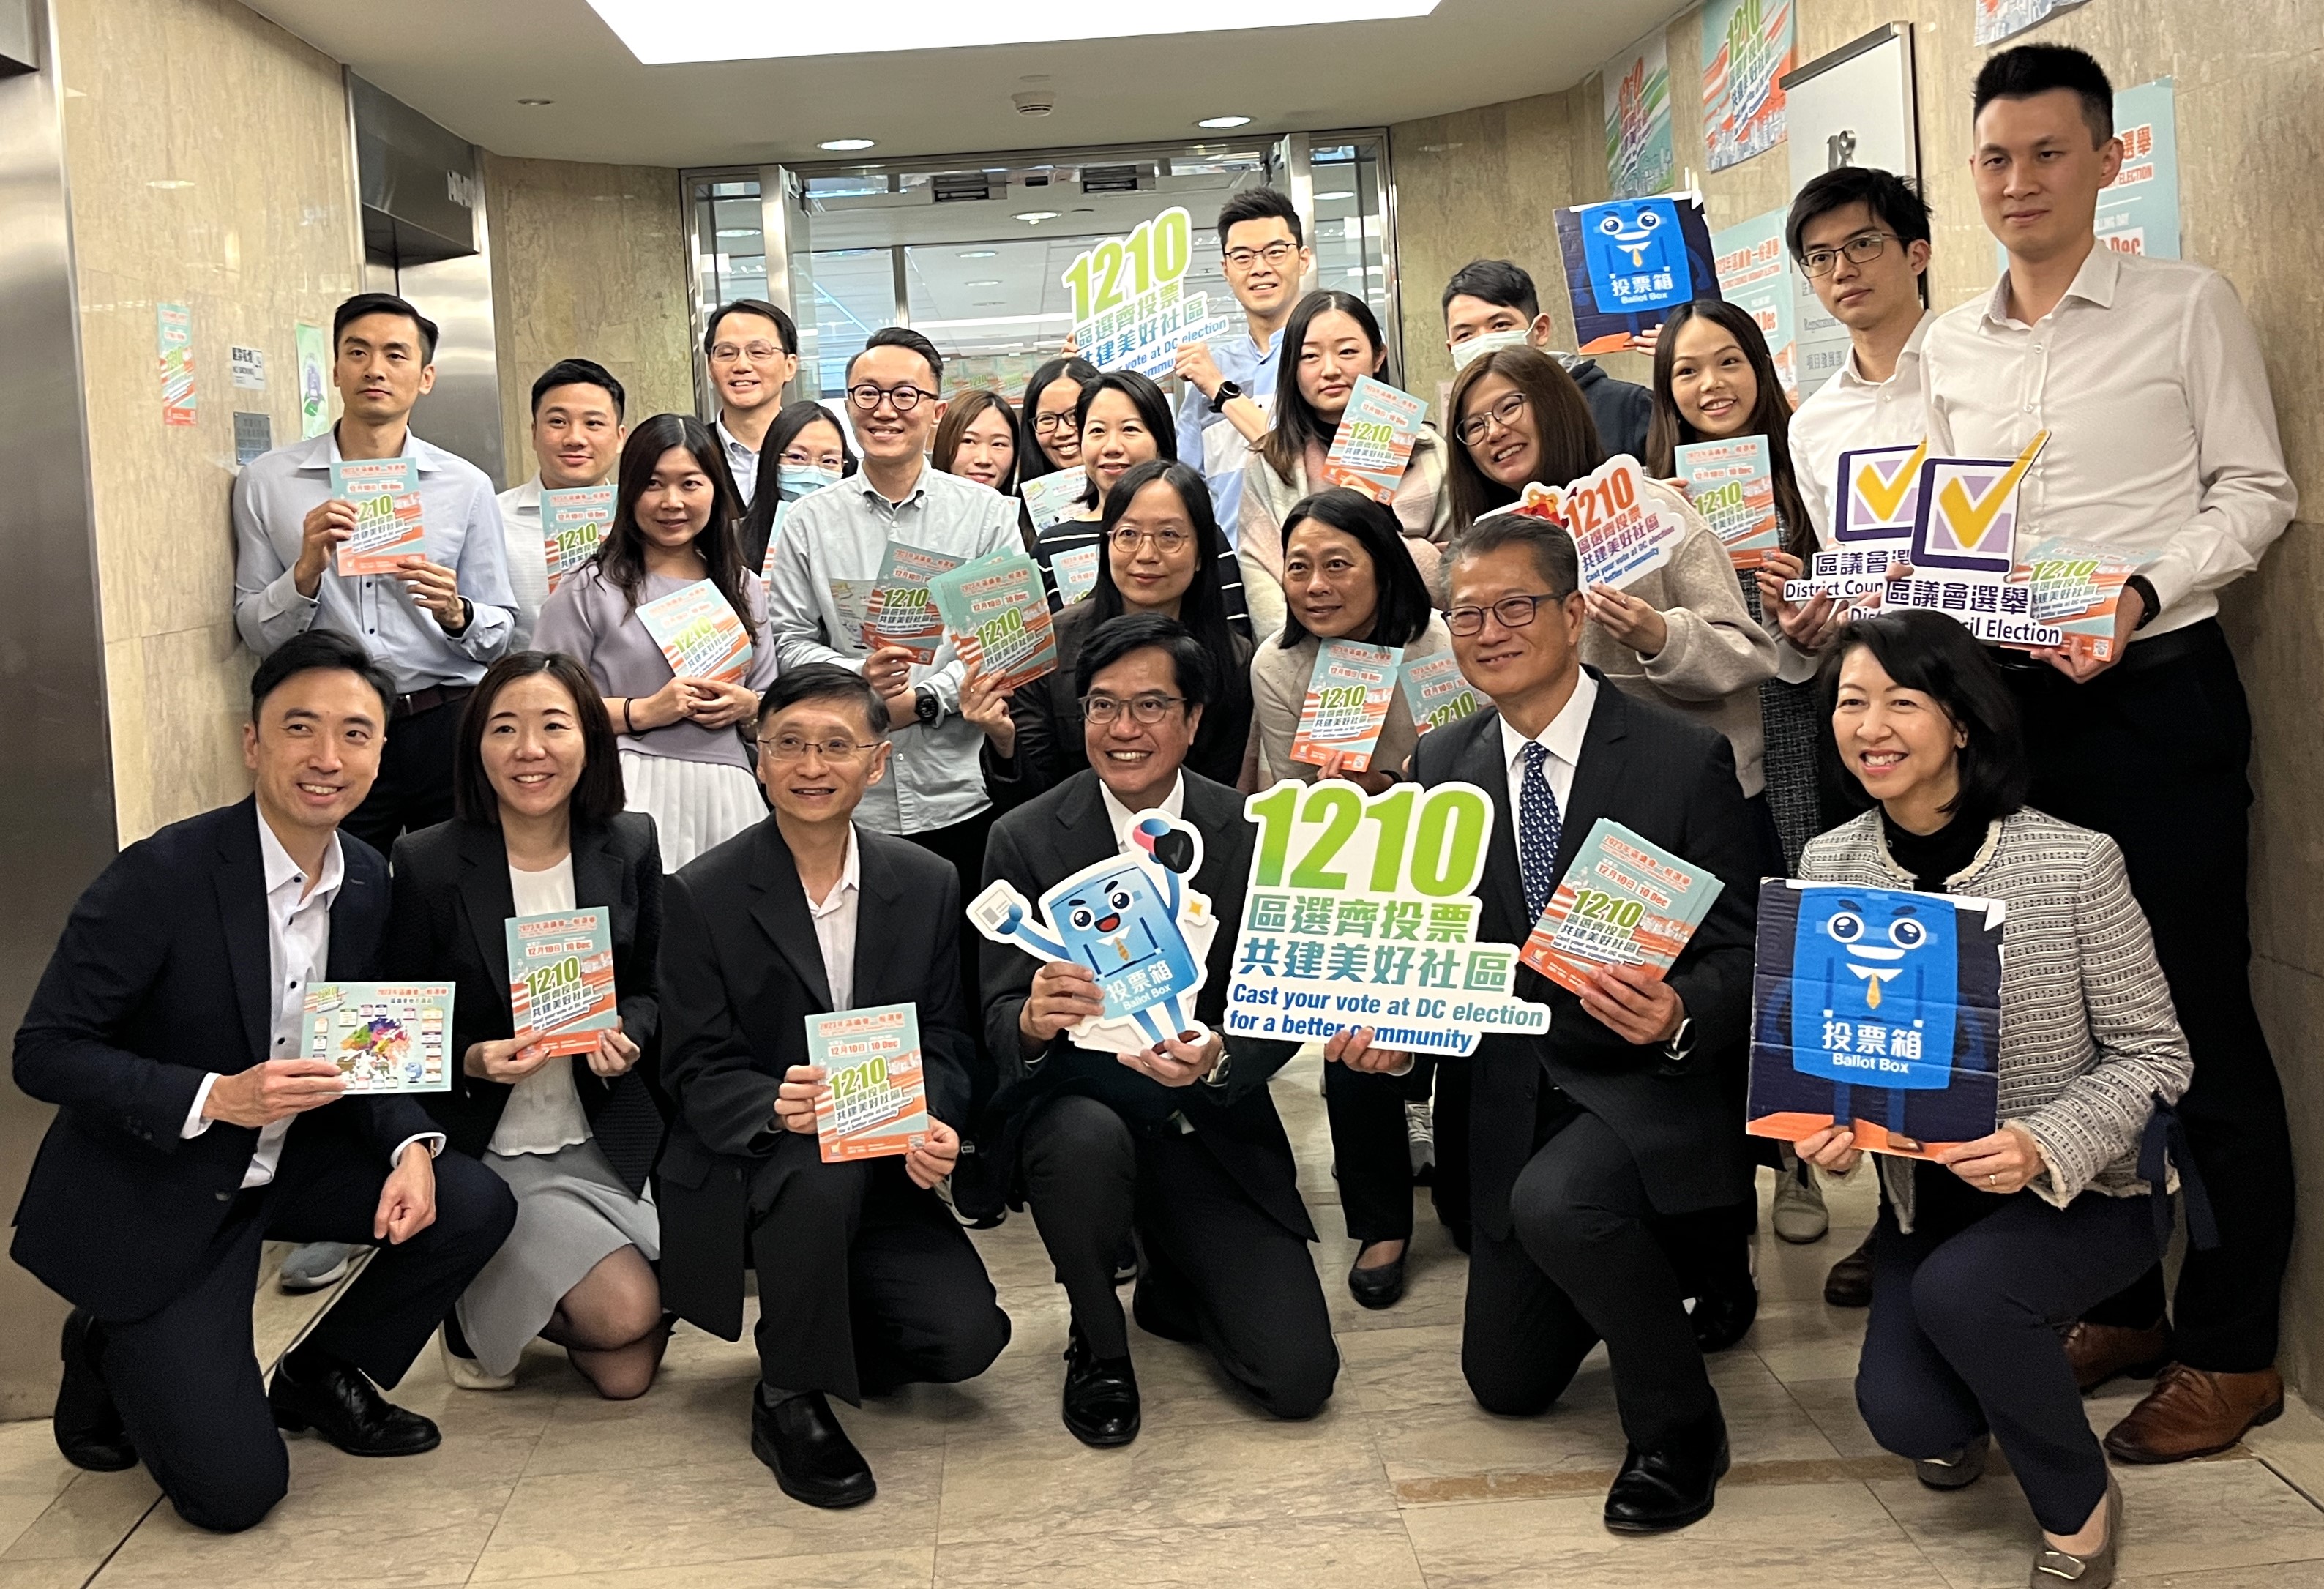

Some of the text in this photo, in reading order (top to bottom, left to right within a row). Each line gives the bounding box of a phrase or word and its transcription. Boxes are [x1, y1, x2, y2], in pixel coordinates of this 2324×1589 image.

[1066, 212, 1187, 324] 1210
[1610, 273, 1673, 296] 投票箱
[1075, 282, 1179, 350] 區選齊投票
[1621, 292, 1668, 304] Ballot Box
[1125, 354, 1147, 370] vote
[1151, 346, 1161, 359] at
[1165, 337, 1178, 353] DC
[1182, 318, 1226, 343] election
[1350, 422, 1392, 443] 1210
[1564, 468, 1634, 539] 1210
[1695, 482, 1741, 516] 1210
[556, 523, 597, 552] 1210
[1582, 513, 1660, 572] 共建美好社區
[1586, 526, 1675, 583] Cast your vote at DC election
[1624, 547, 1659, 572] community
[2030, 561, 2099, 582] 1210
[883, 588, 929, 607] 1210
[1886, 579, 2028, 615] 區議會選舉
[673, 617, 712, 653] 1210
[975, 608, 1022, 648] 1210
[1987, 618, 2060, 643] Election
[1320, 686, 1366, 709] 1210
[1428, 692, 1475, 729] 1210
[1252, 788, 1485, 897] 1210
[1598, 864, 1668, 907] 12月10日 10 Dec
[1247, 894, 1473, 943] 區選齊投票
[1572, 889, 1643, 927] 1210
[1561, 924, 1638, 952] 共建美好社區
[526, 957, 579, 998] 1210
[1106, 960, 1173, 1003] 投票箱
[1238, 937, 1512, 992] 共建美好社區
[1122, 984, 1172, 1010] Ballot Box
[1233, 984, 1543, 1027] Cast your vote at DC election
[1229, 1010, 1259, 1029] for
[1263, 1017, 1275, 1031] a
[830, 1040, 898, 1055] 12月10日 10 Dec
[1822, 1020, 1922, 1060] 投票箱
[829, 1057, 886, 1100] 1210
[1832, 1052, 1910, 1074] Ballot Box
